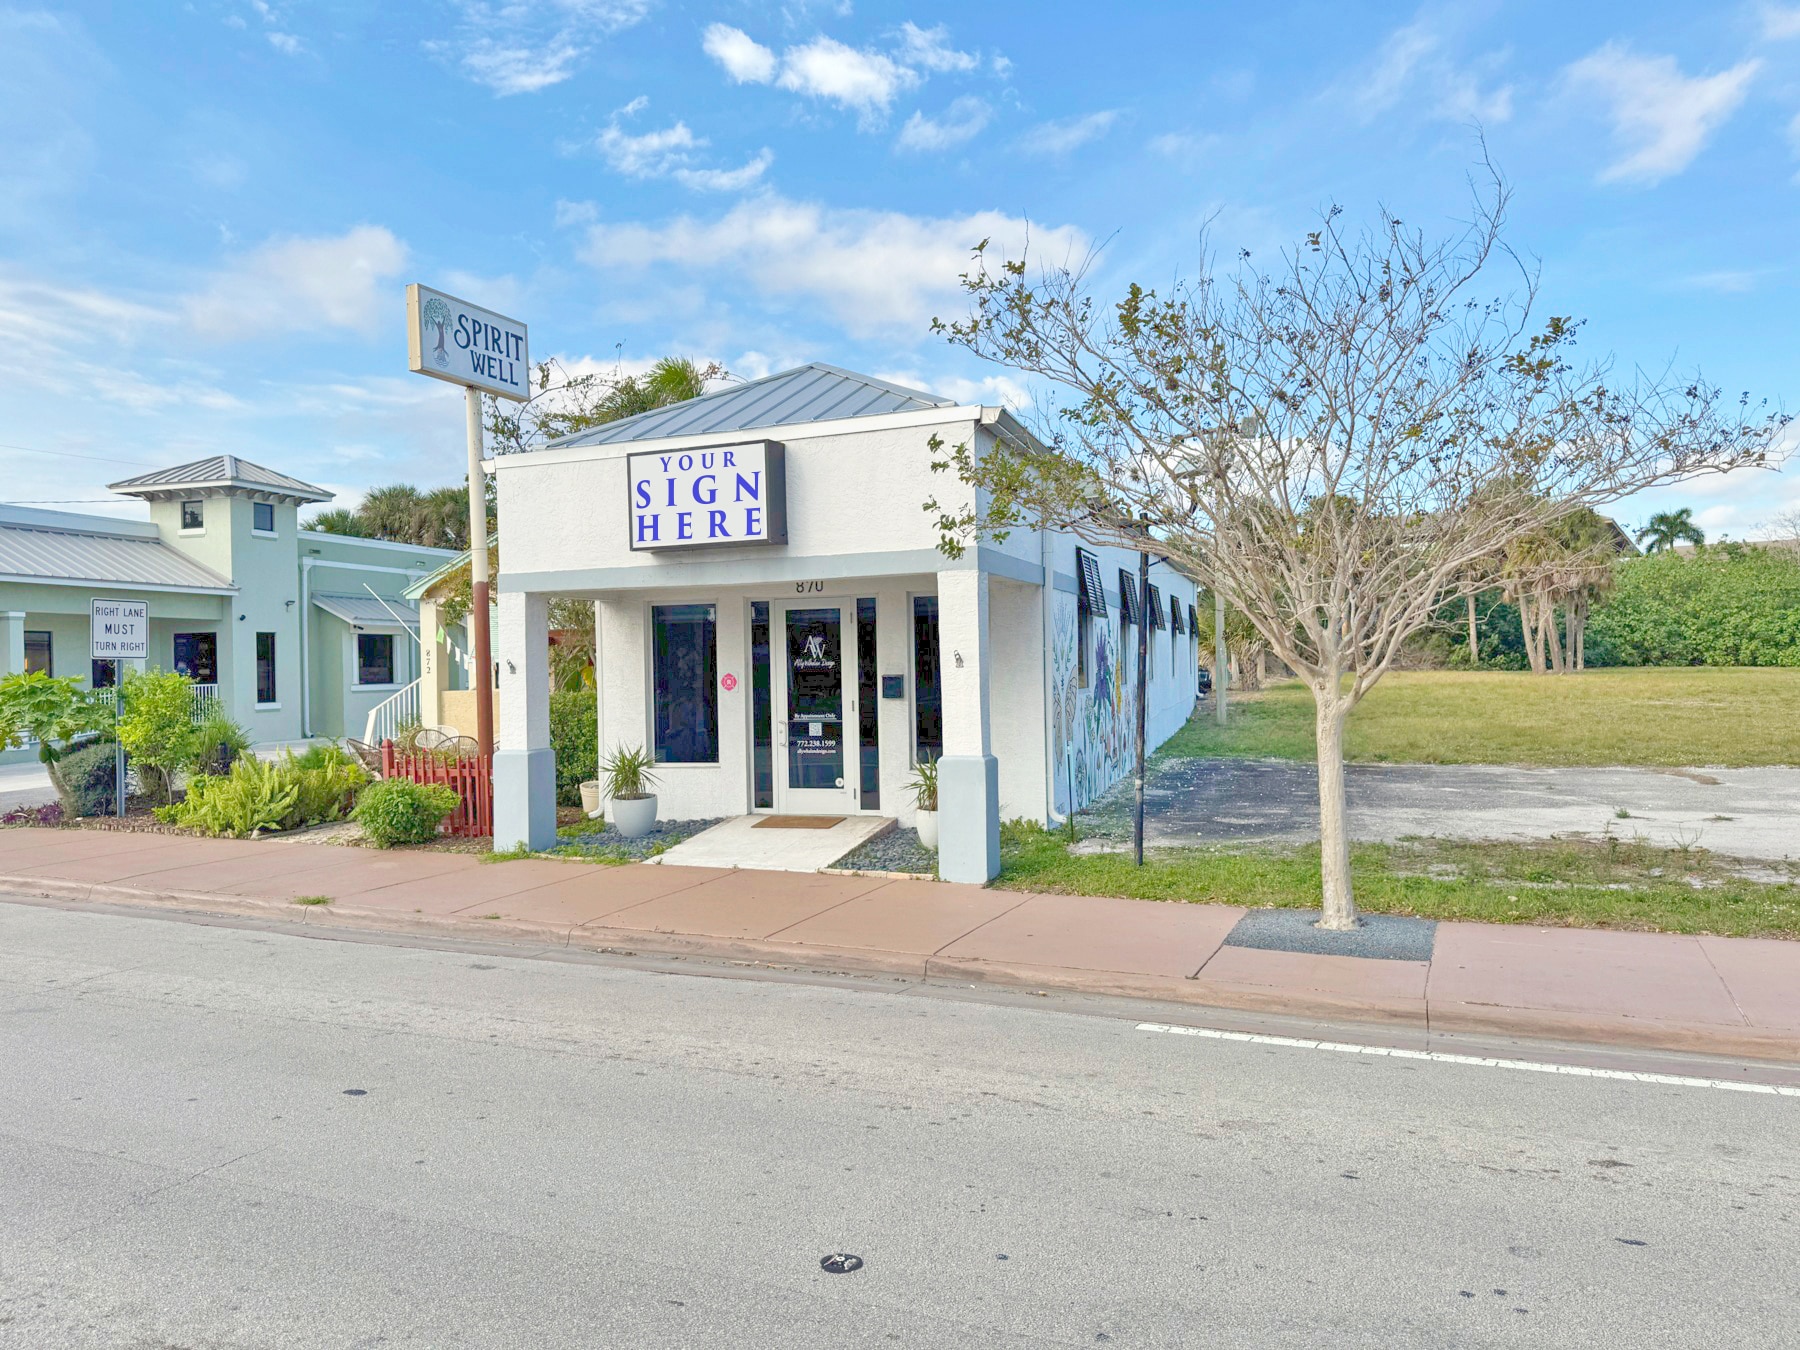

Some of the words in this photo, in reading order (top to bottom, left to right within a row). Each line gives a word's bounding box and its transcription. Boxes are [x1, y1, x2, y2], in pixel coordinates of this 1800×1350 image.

[454, 314, 524, 361] SPIRIT
[470, 350, 519, 386] WELL
[660, 451, 737, 473] YOUR
[636, 471, 762, 509] SIGN
[636, 507, 762, 543] HERE
[95, 606, 119, 617] RIGHT
[123, 608, 145, 618] LANE
[105, 623, 135, 636] MUST
[95, 641, 117, 651] TURN
[120, 641, 145, 652] RIGHT
